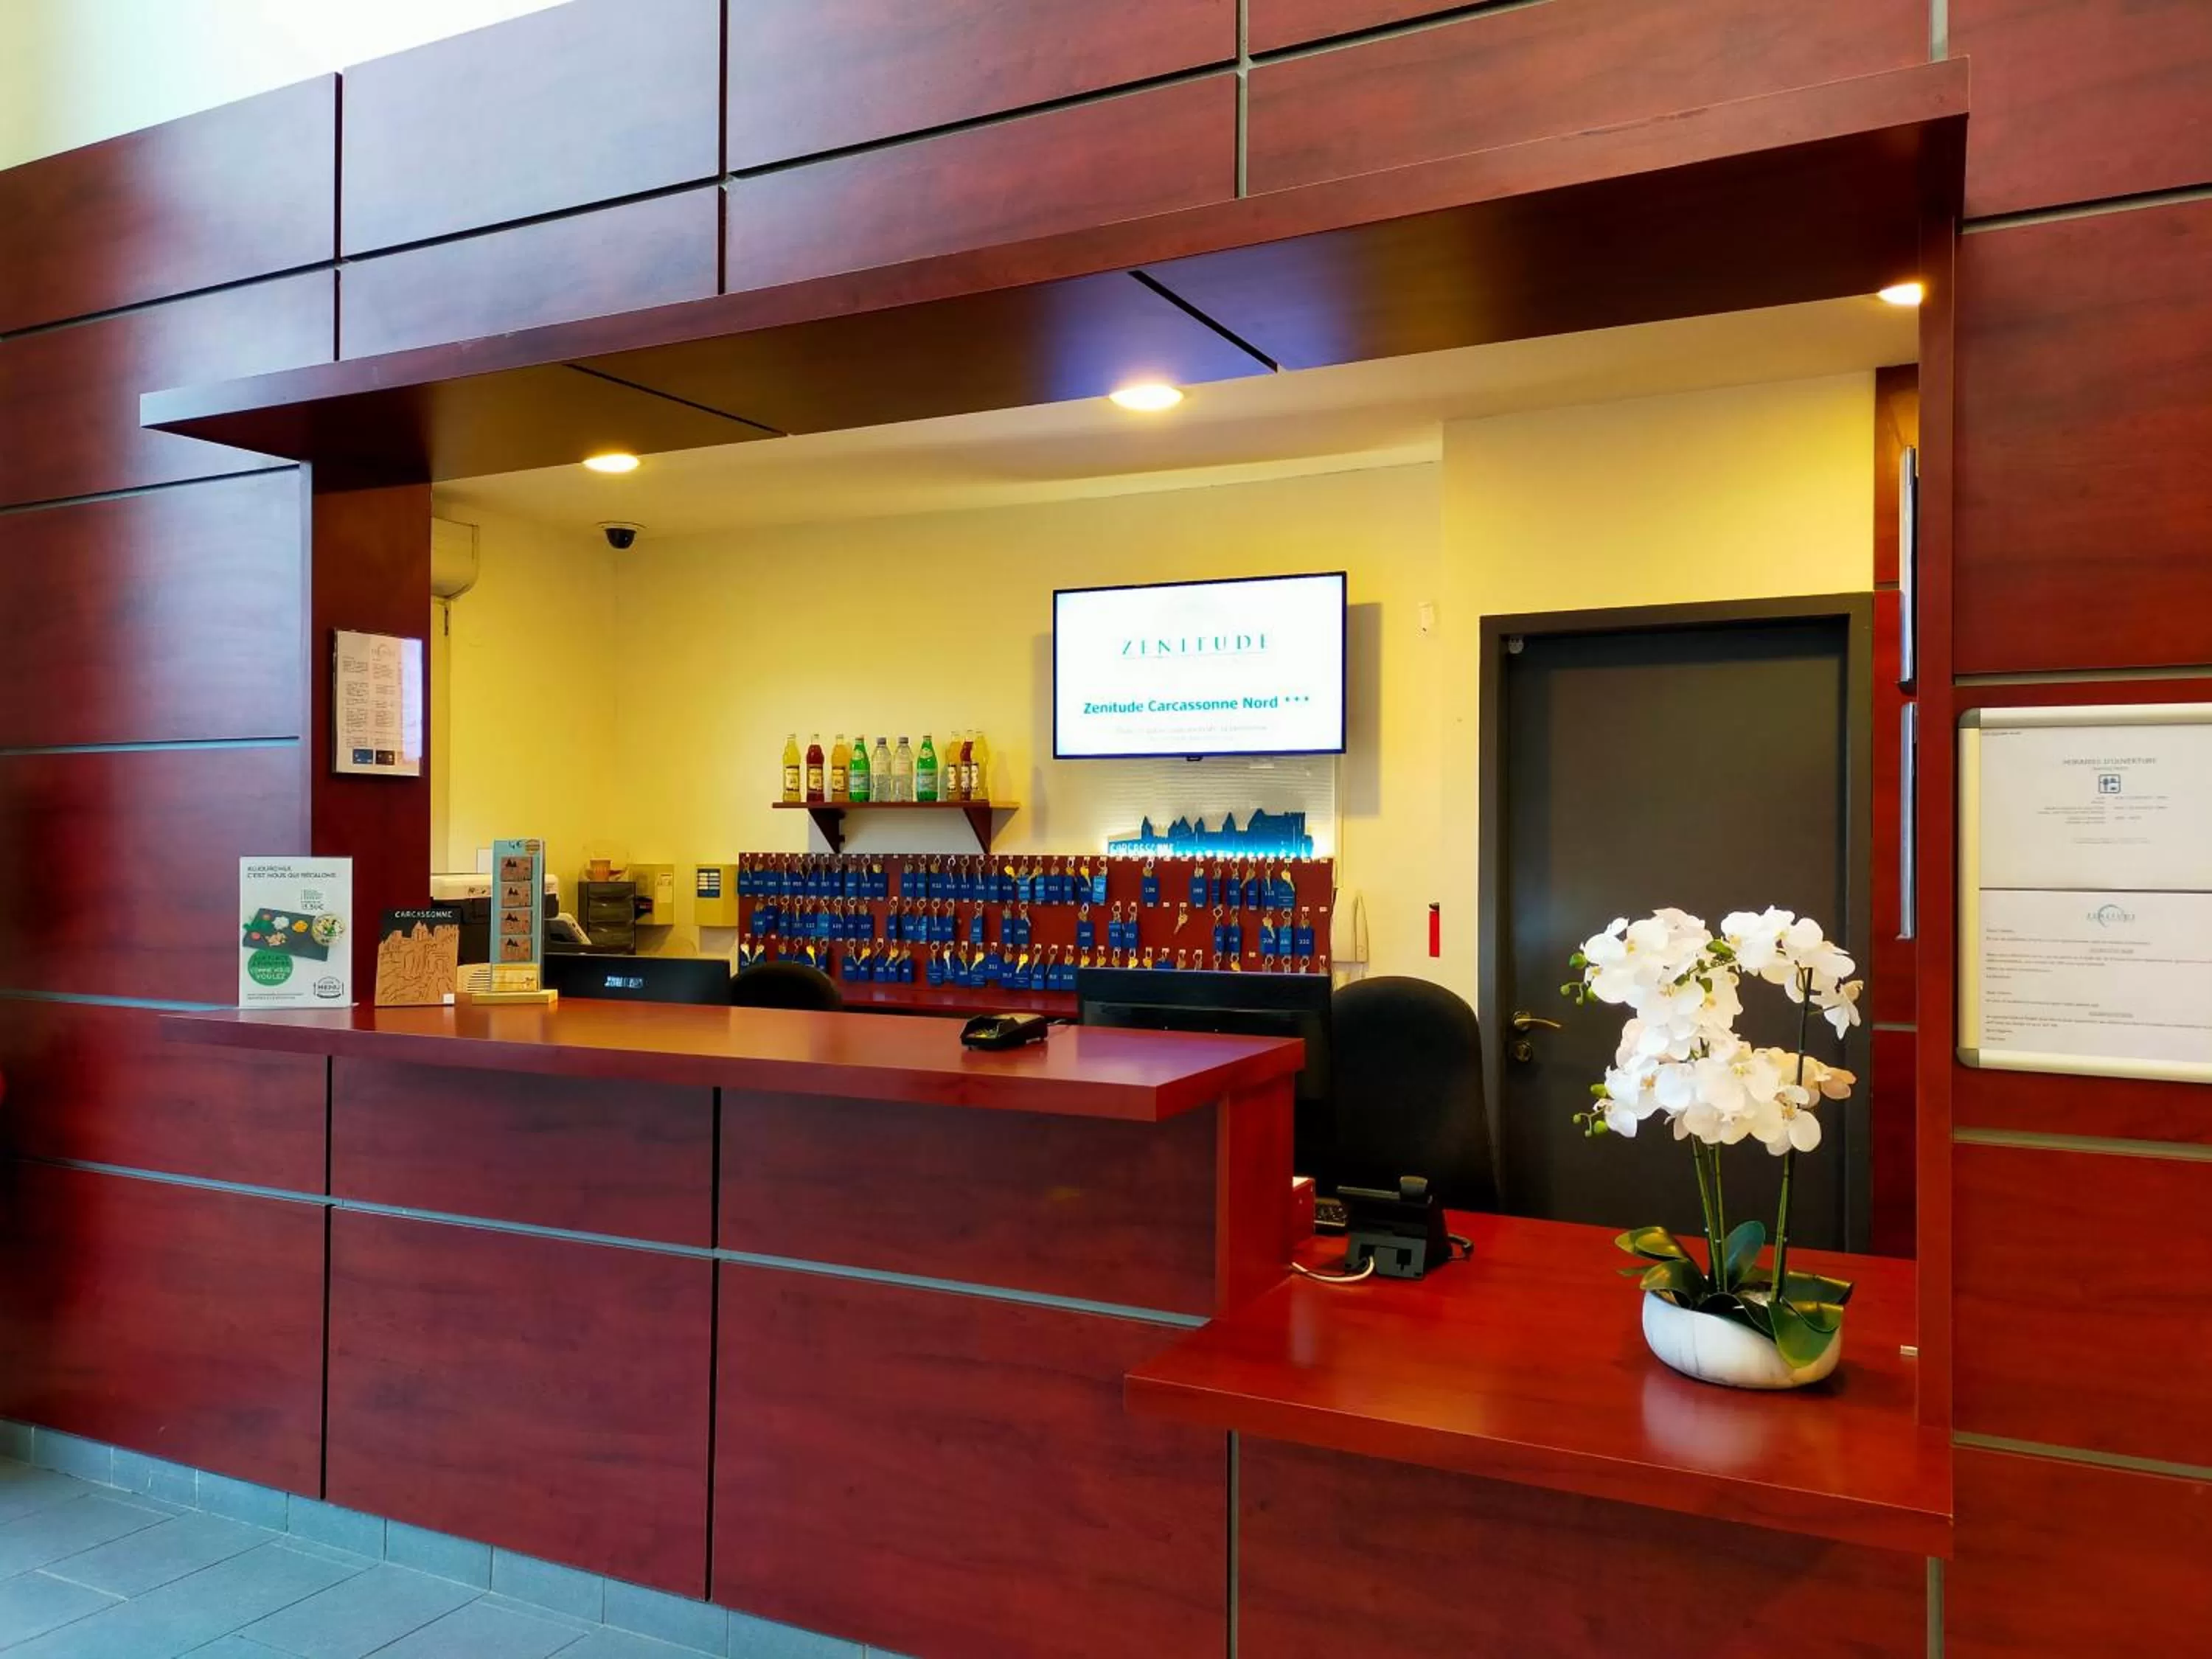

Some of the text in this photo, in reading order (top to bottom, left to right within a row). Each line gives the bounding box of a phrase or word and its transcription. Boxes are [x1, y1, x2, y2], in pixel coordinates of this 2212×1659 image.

[1121, 633, 1267, 655] ZENITUDE
[1083, 695, 1279, 714] Zenitude Carcassonne Nord
[394, 910, 453, 919] CARCASSONNE
